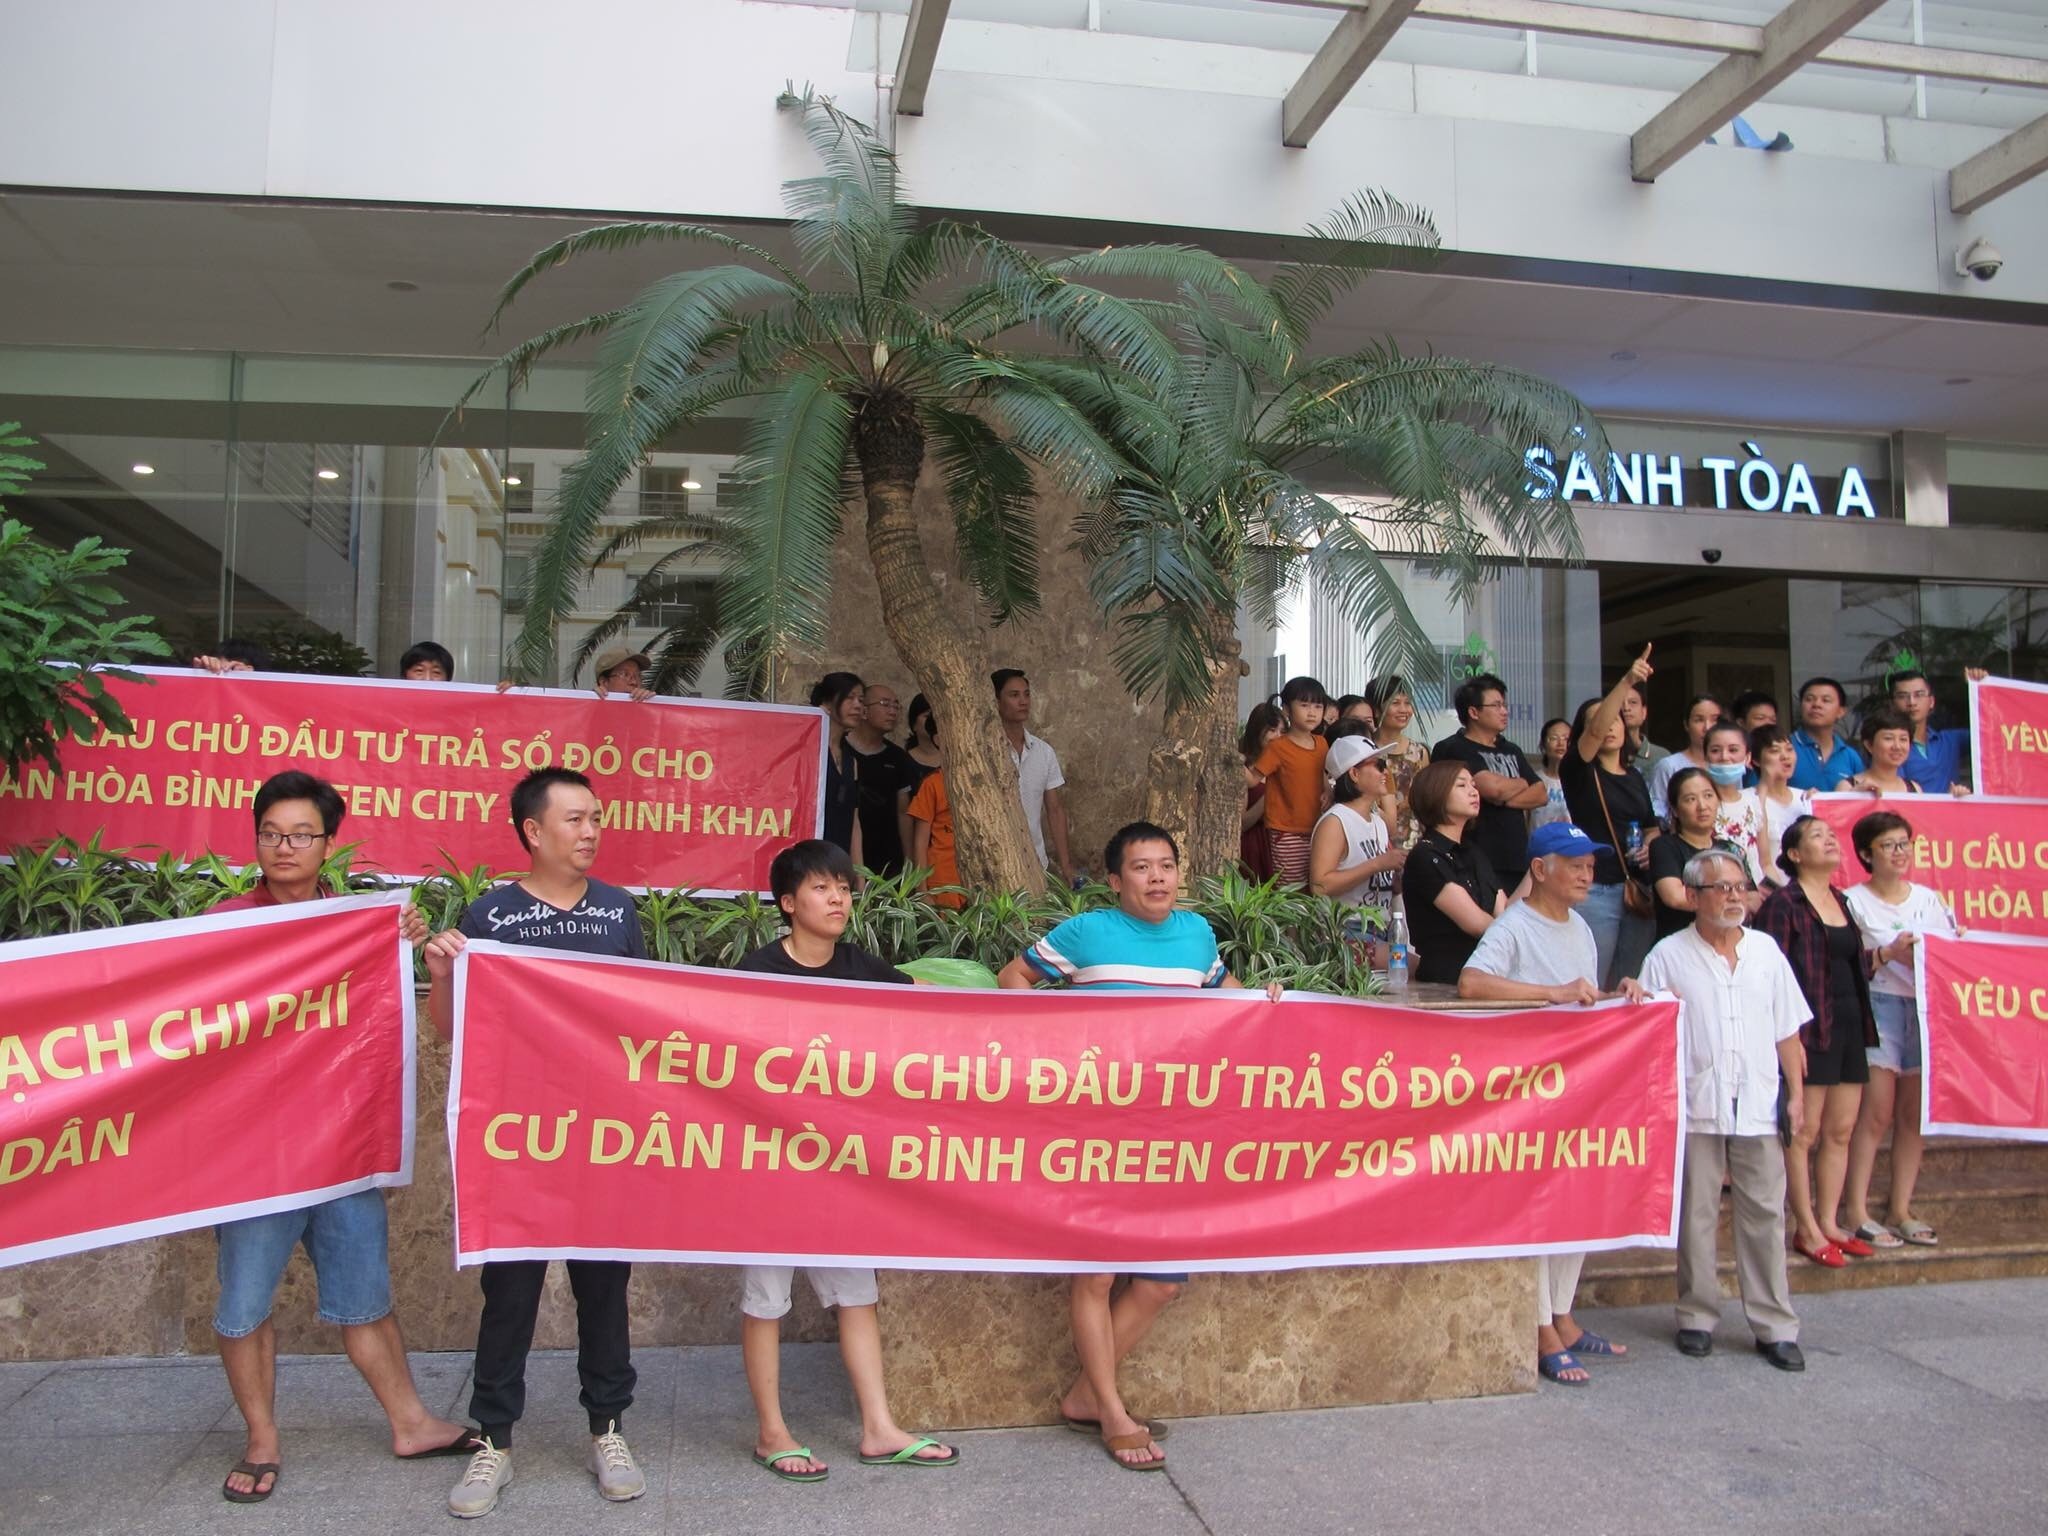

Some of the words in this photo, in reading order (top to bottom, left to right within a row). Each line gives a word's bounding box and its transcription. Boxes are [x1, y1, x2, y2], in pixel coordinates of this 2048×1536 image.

[1702, 440, 1821, 515] TÒA
[1836, 467, 1876, 519] A
[165, 713, 250, 755] CHỦ
[258, 718, 345, 760] ĐẦU
[352, 727, 410, 763] TƯ
[414, 727, 490, 769] TRẢ
[500, 730, 553, 771] SỔ
[560, 735, 622, 776] ĐỎ
[631, 746, 715, 781] CHO
[66, 765, 153, 805] HÒA
[164, 769, 262, 810] BÌNH
[411, 788, 499, 823] CITY
[702, 804, 793, 838] KHAI
[1962, 832, 2026, 869] CẦU
[487, 902, 558, 931] South
[1964, 884, 2034, 919] HÒA
[149, 1000, 251, 1061] CHI
[262, 970, 354, 1038] PHÍ
[1951, 976, 2021, 1019] YÊU
[618, 1030, 739, 1089] YÊU
[753, 1033, 877, 1098] CẦU
[892, 1041, 1013, 1104] CHỦ
[1025, 1045, 1144, 1107] ĐẦU
[1155, 1057, 1229, 1108] TƯ
[1235, 1052, 1327, 1110] TRẢ
[1338, 1050, 1399, 1110] SỔ
[1407, 1053, 1476, 1108] ĐỎ
[1482, 1061, 1567, 1103] CHO
[0, 1111, 136, 1186] DÂN
[483, 1108, 579, 1163] CƯ
[589, 1110, 726, 1170] DÂN
[740, 1121, 870, 1177] HÒA
[887, 1125, 1026, 1183] BÌNH
[1039, 1137, 1213, 1184] GREEN
[1223, 1140, 1331, 1184] CITY
[1334, 1135, 1419, 1180] 505
[1428, 1130, 1546, 1176] MINH
[1551, 1125, 1648, 1170] KHAI
